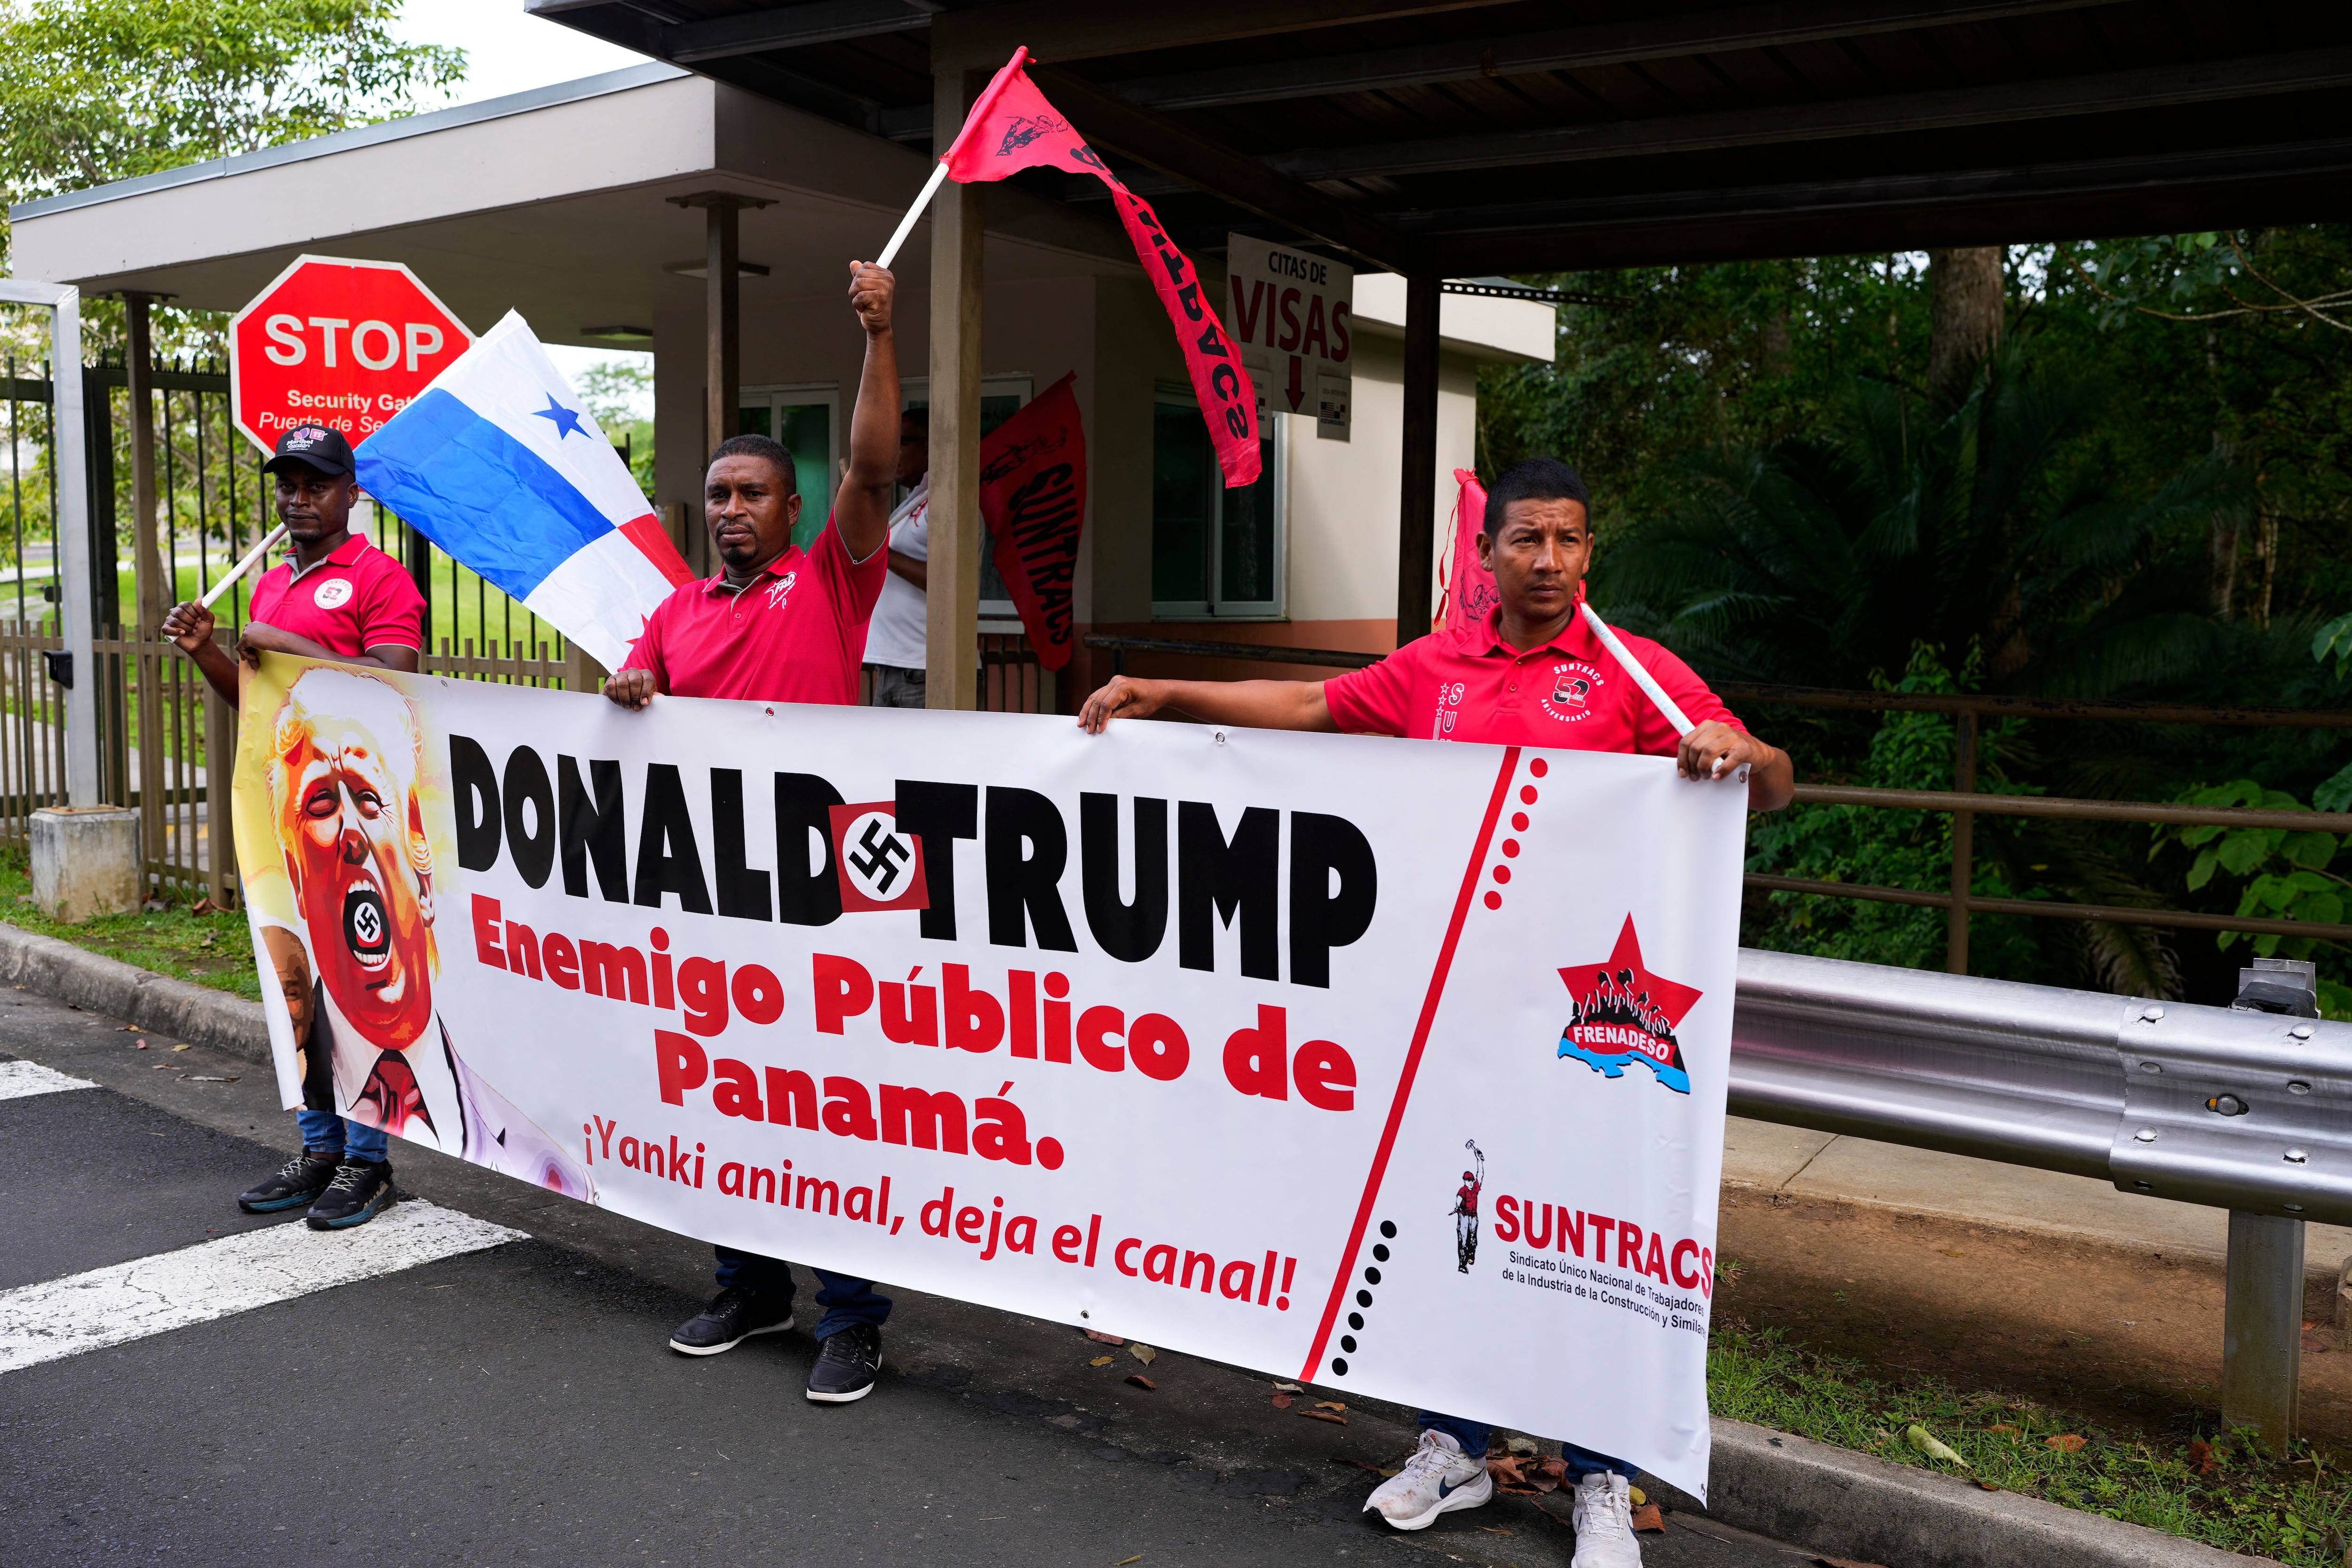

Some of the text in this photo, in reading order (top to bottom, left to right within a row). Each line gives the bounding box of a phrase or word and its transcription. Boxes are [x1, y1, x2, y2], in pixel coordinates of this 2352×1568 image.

[1269, 251, 1327, 286] CITAS DE
[264, 314, 444, 372] STOP
[1231, 274, 1349, 363] VISAS
[287, 390, 372, 414] Security
[329, 416, 353, 432] de
[1552, 676, 1590, 708] 52
[1553, 662, 1605, 686] SUNTRACS
[1541, 698, 1592, 722] ANIVERSARIO
[449, 734, 1377, 989] DONALD TRUMP
[471, 893, 1357, 1112] Enemigo Público de
[1573, 1027, 1669, 1060] FRENADESO
[654, 1029, 1064, 1170] Panamá.
[583, 1114, 1297, 1312] ¡Yanki animal, deja el canal!
[1494, 1195, 1712, 1300] SUNTRACS
[1502, 1268, 1514, 1281] de
[1517, 1270, 1525, 1283] la
[1528, 1273, 1572, 1293] Industria
[1575, 1284, 1586, 1297] de
[1589, 1287, 1597, 1300] la
[1601, 1290, 1660, 1323] Construcción
[1662, 1315, 1668, 1328] y
[1510, 1250, 1704, 1317] Sindicato Único Nacional de Trabajadores
